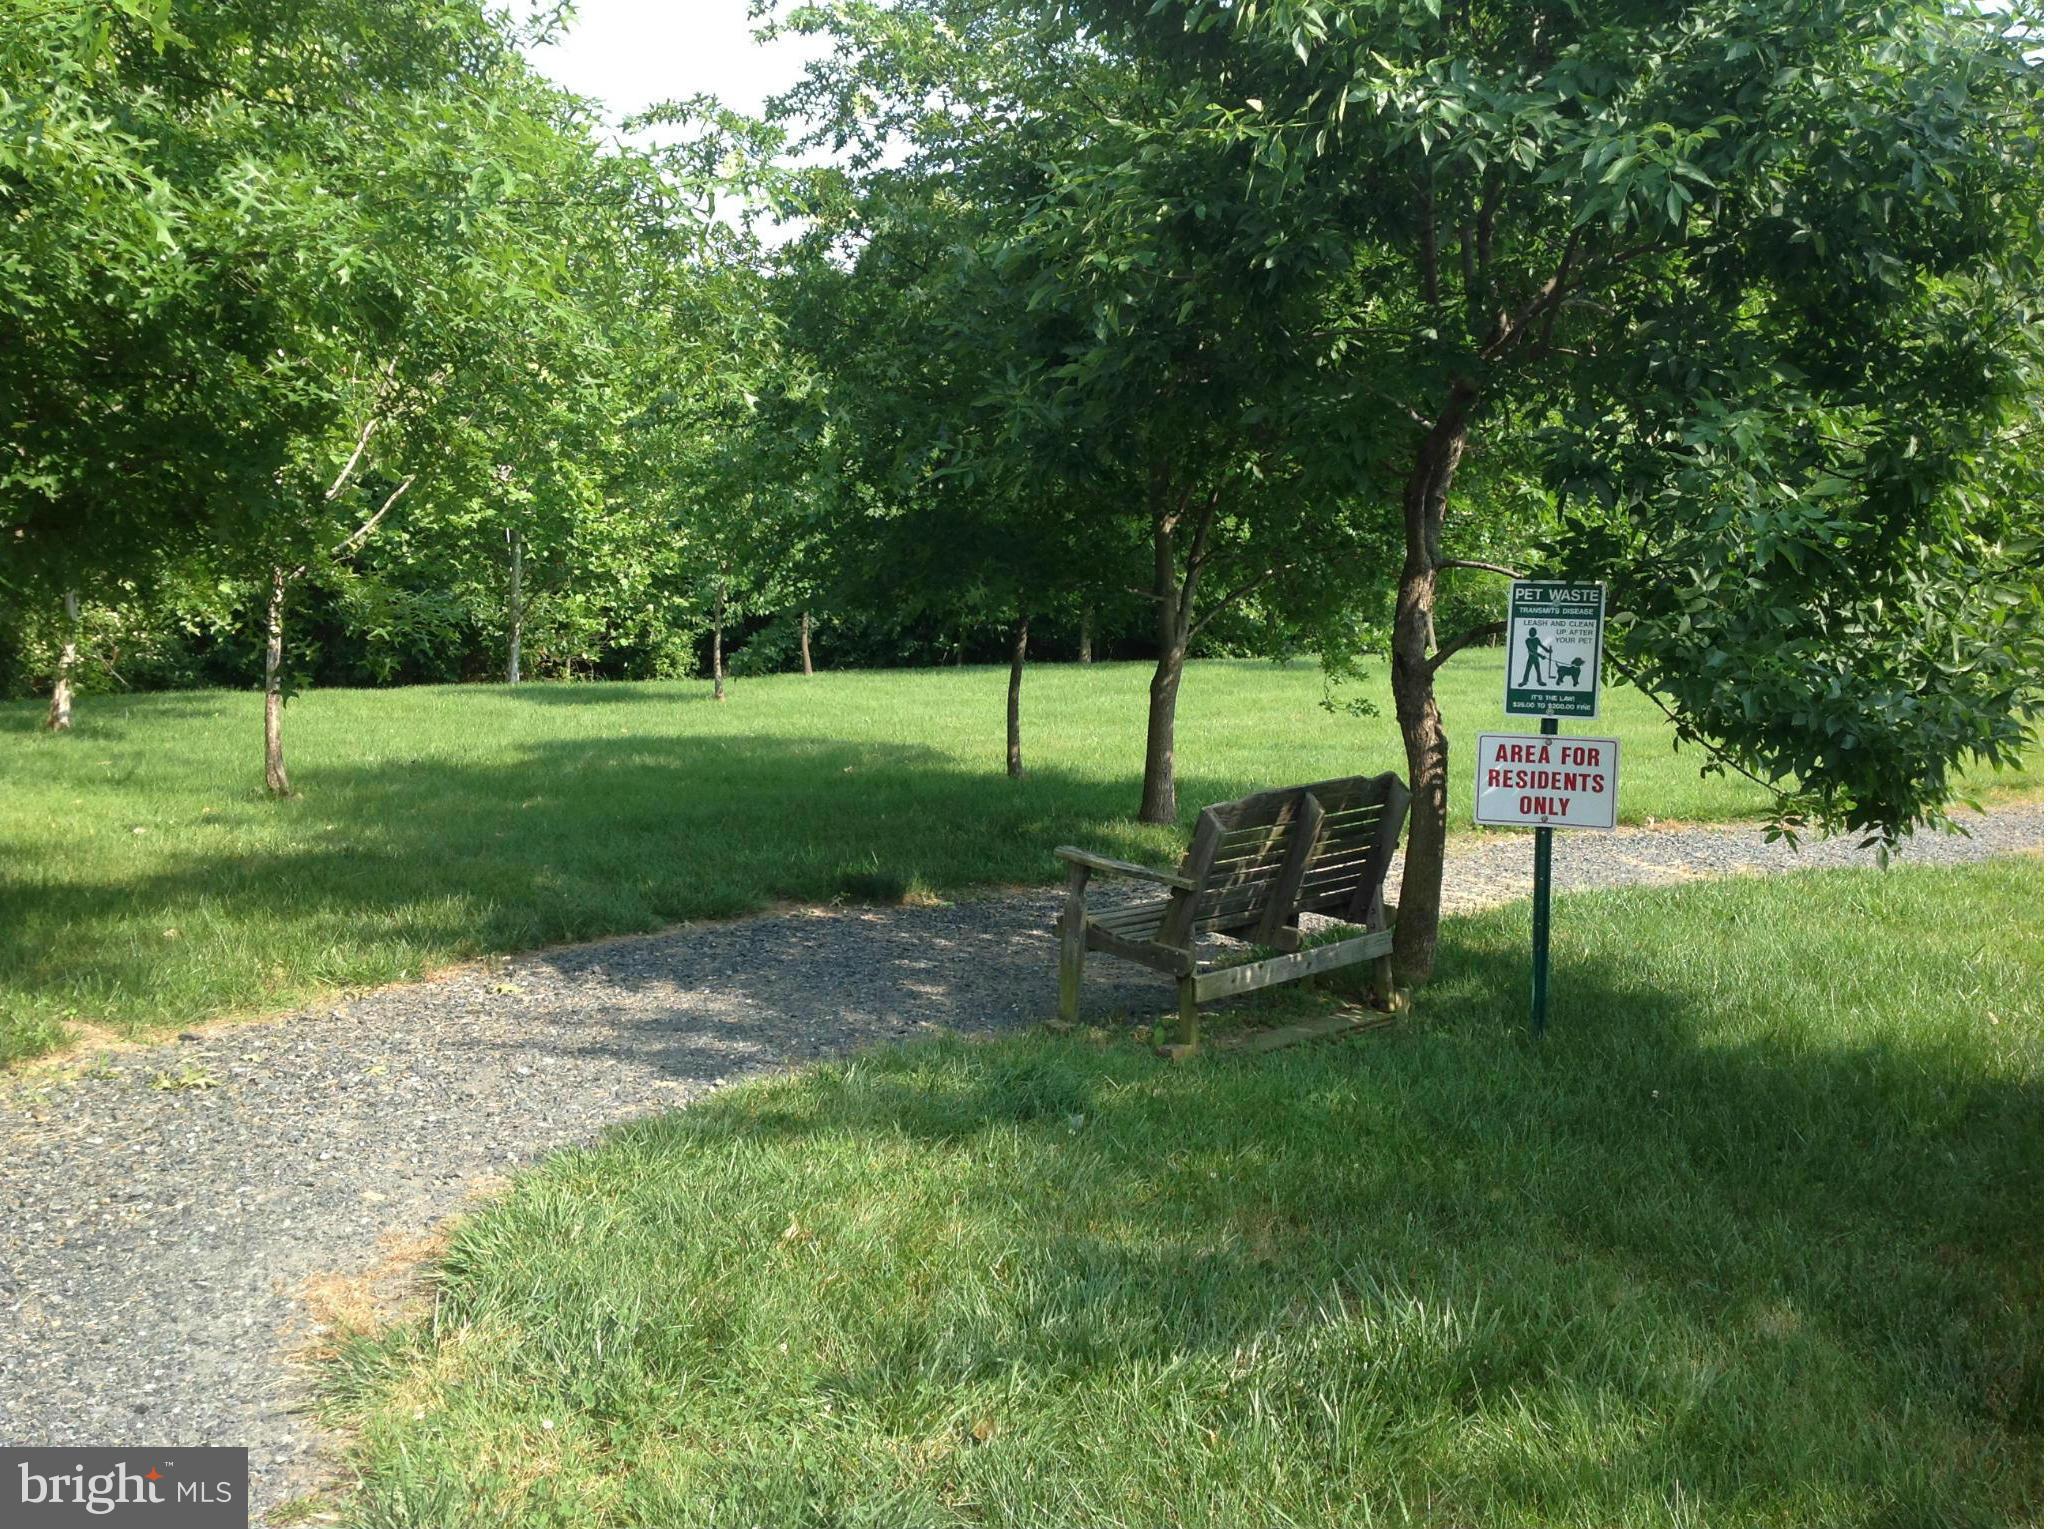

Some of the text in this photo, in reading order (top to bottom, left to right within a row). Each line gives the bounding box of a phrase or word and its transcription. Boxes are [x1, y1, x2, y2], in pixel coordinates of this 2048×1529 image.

[1515, 588, 1599, 602] PET WASTE
[1520, 607, 1560, 615] TRANSMITS
[1495, 743, 1600, 767] AREA FOR
[1488, 768, 1605, 793] RESIDENTS
[1519, 795, 1571, 816] ONLY
